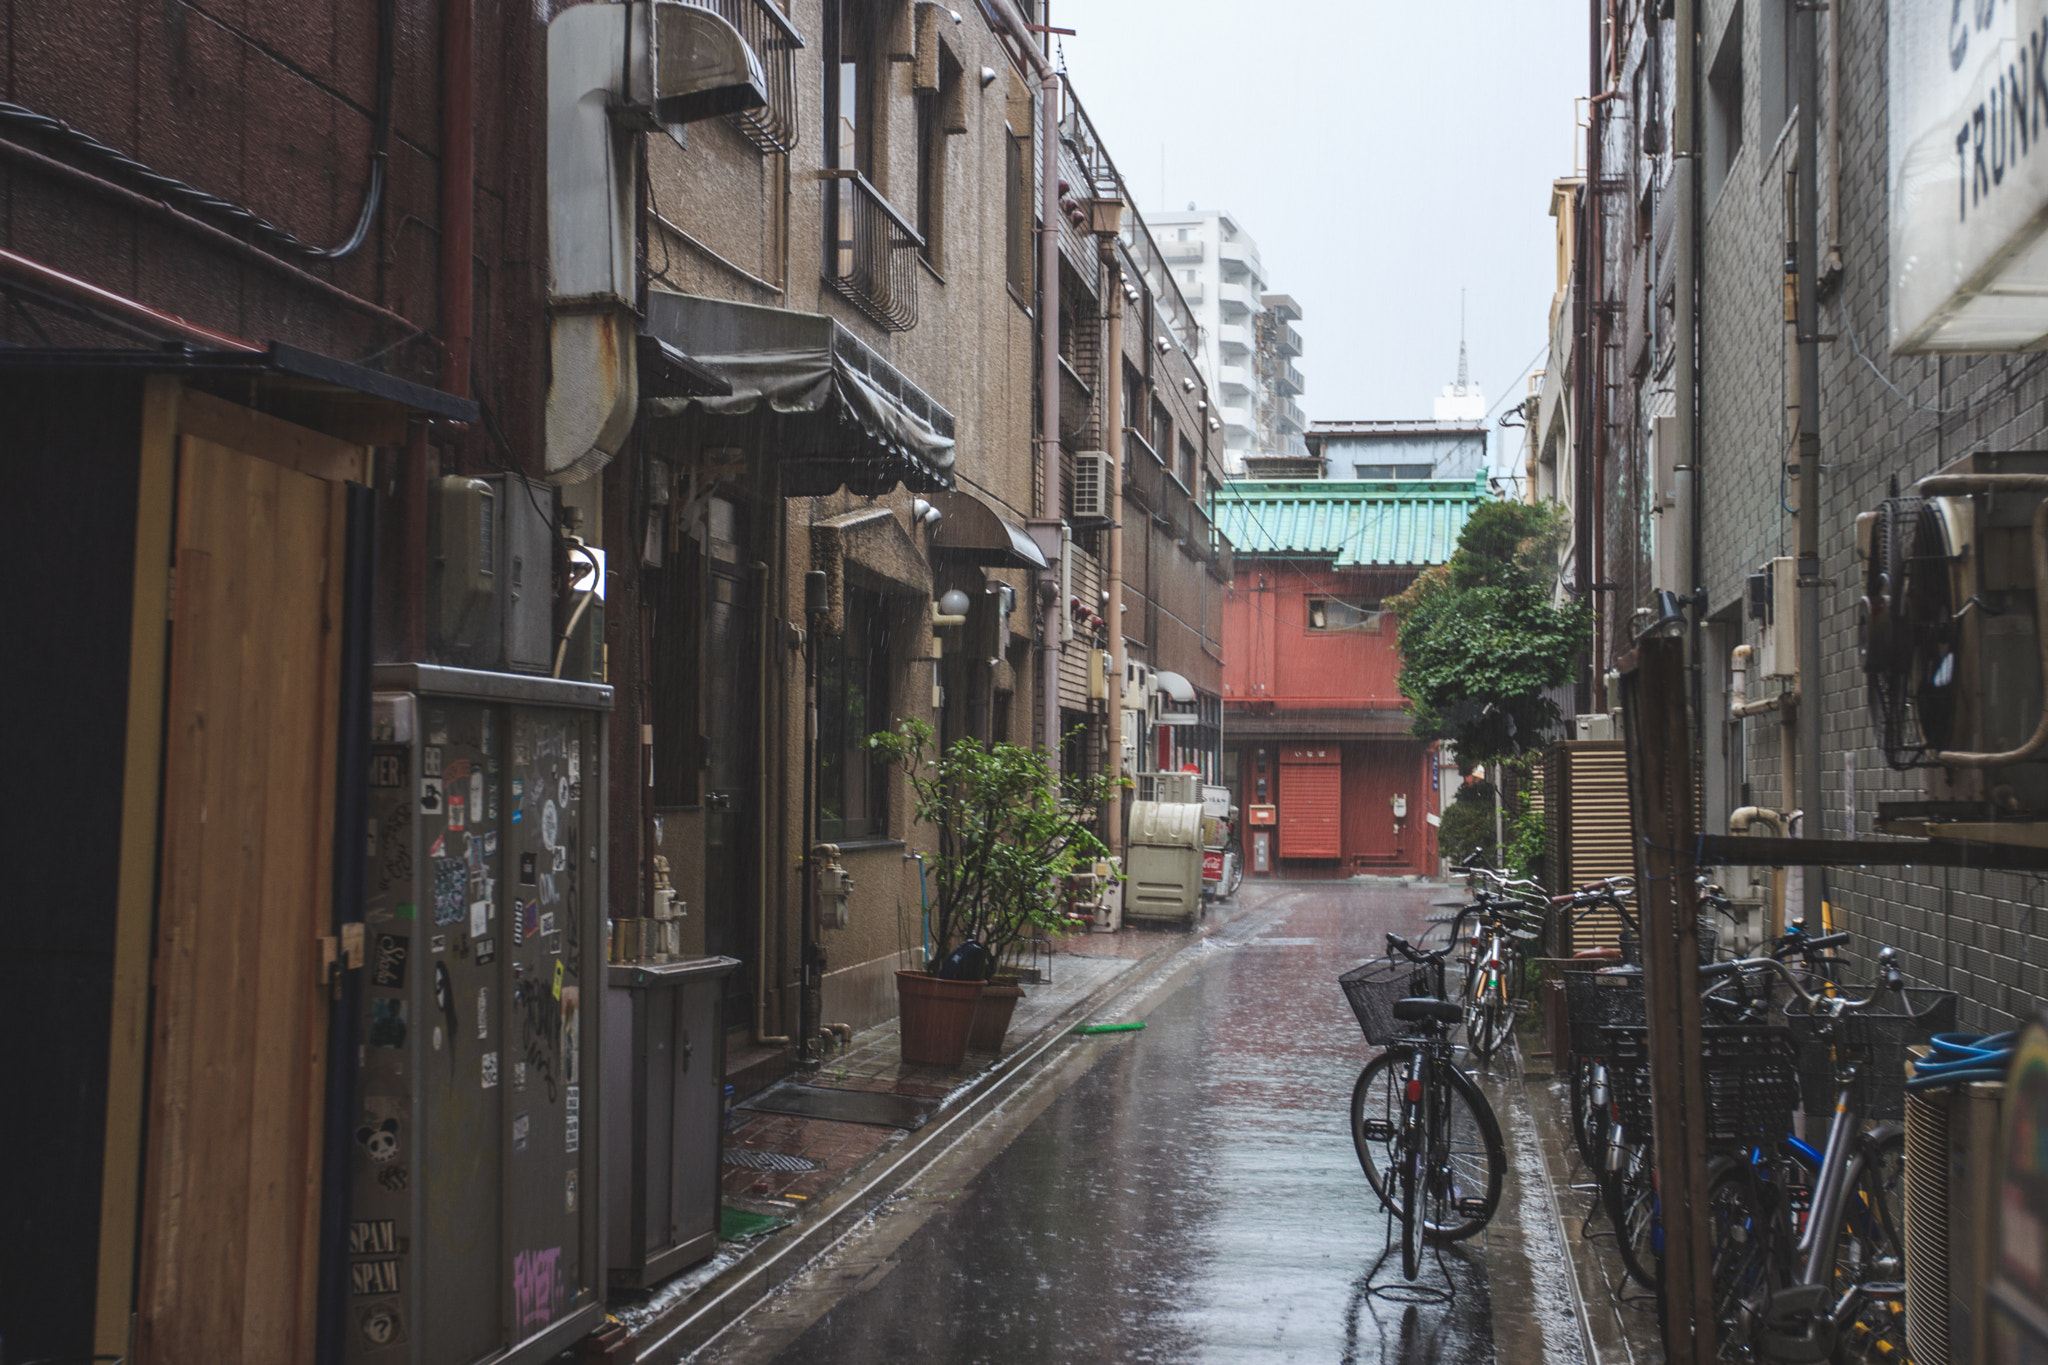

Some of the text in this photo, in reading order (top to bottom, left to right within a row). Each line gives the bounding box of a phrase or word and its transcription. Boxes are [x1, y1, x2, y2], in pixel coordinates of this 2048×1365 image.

[1956, 15, 2048, 223] TRUNK
[349, 1220, 395, 1253] SPAM
[351, 1260, 399, 1294] SPAM
